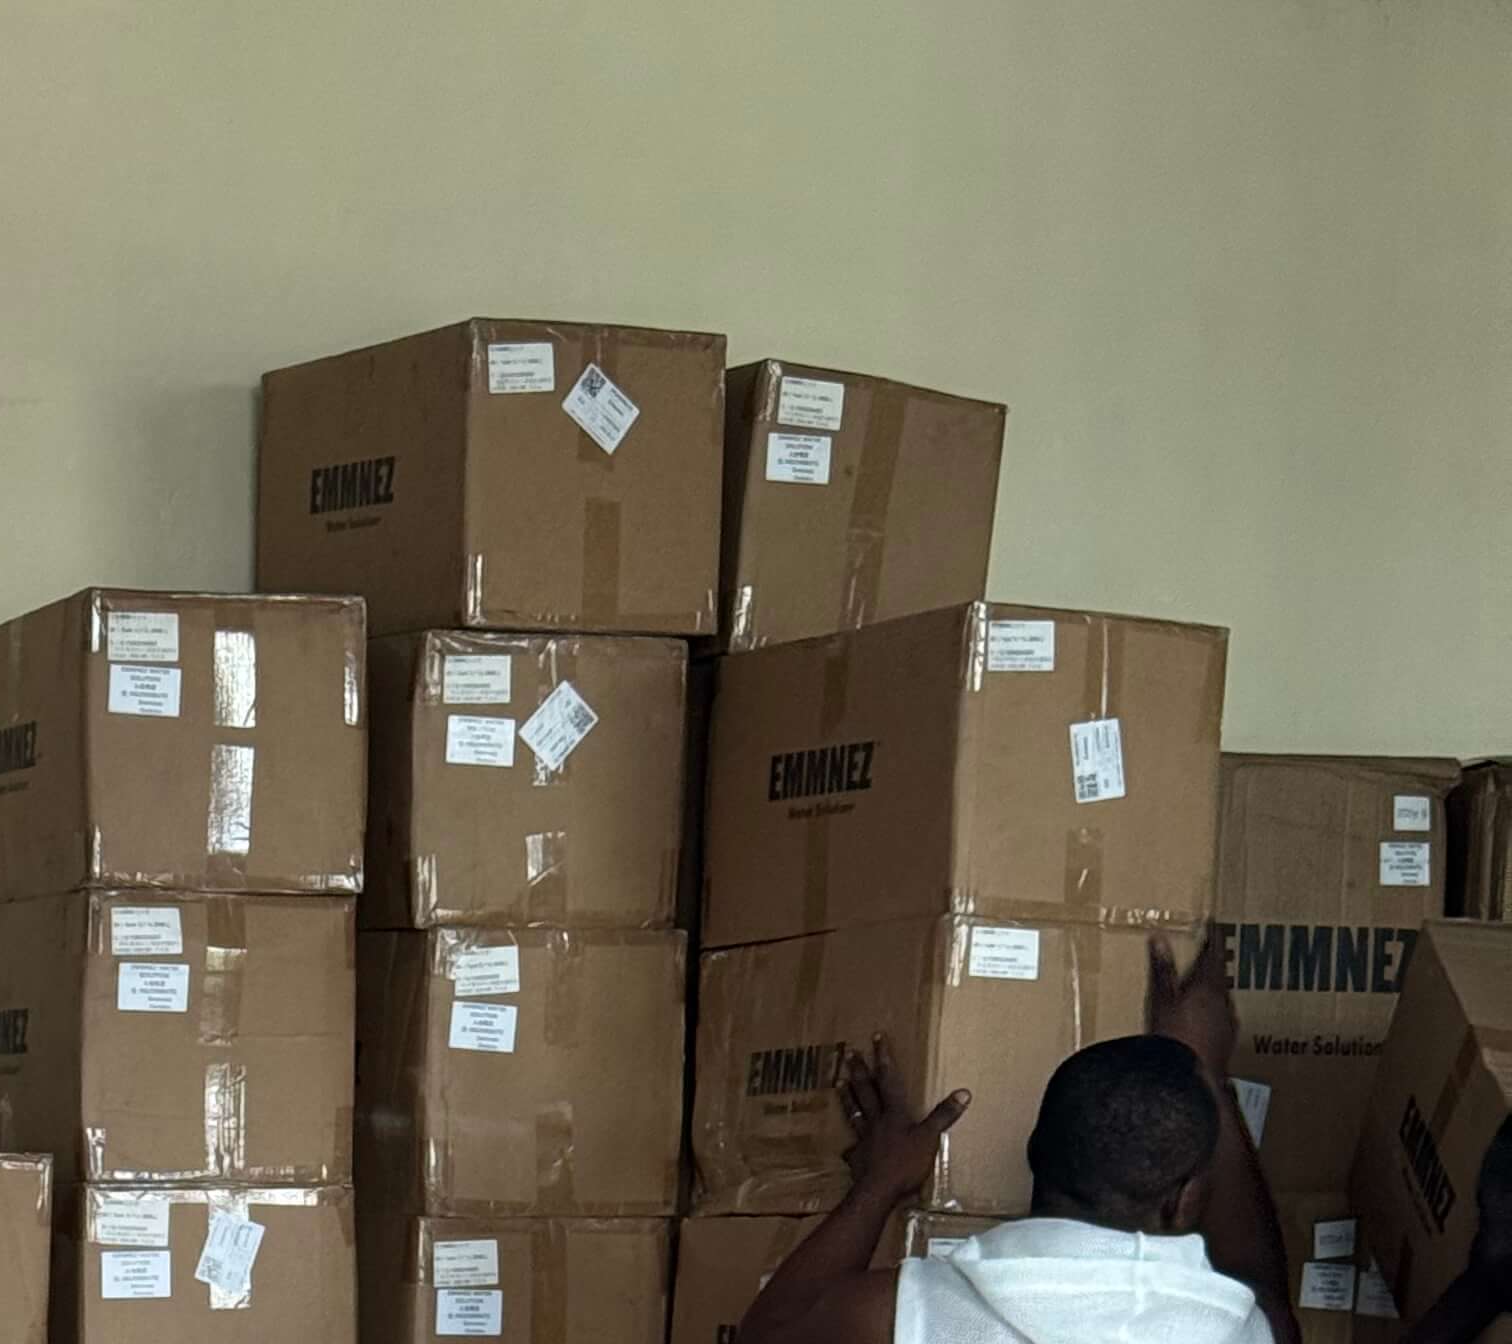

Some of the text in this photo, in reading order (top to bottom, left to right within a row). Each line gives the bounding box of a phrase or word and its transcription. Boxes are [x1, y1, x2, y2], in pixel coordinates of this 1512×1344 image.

[310, 455, 396, 516] EMMNEZ
[768, 740, 875, 803] EMMNEZ
[1253, 1033, 1305, 1058] Water
